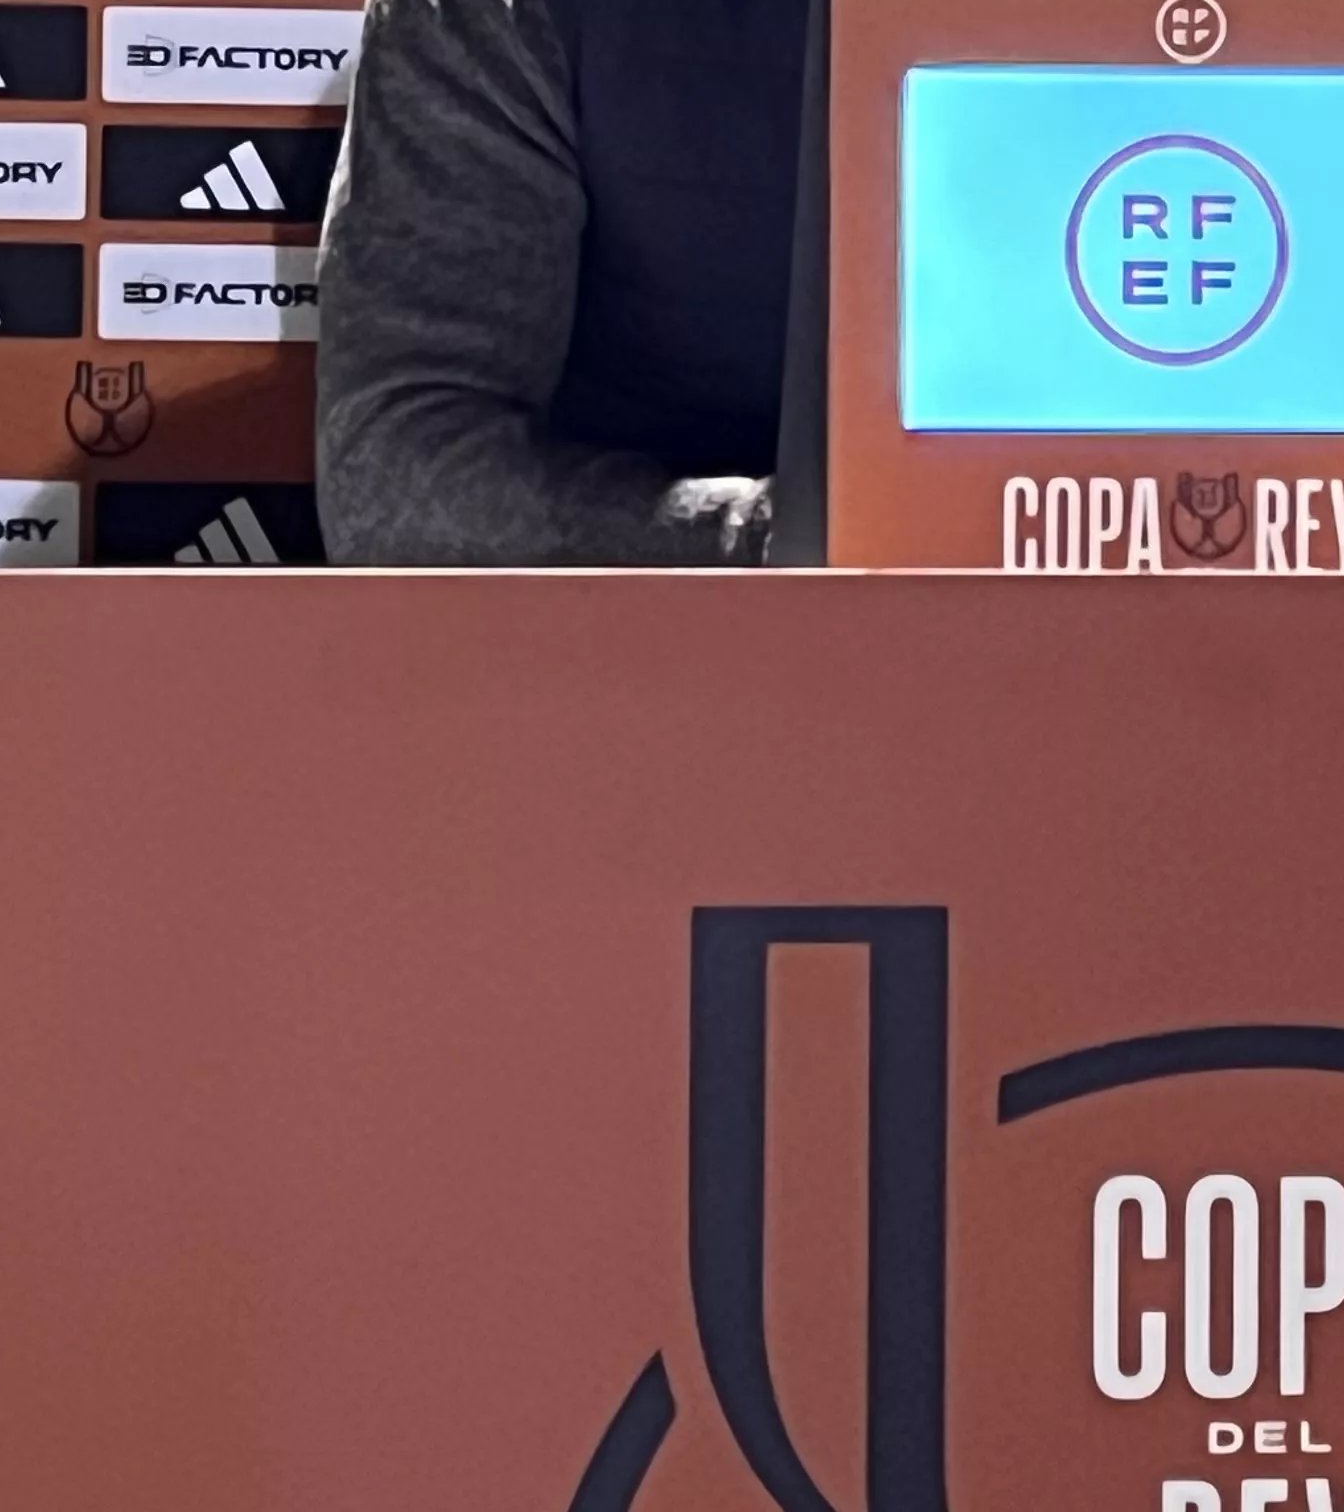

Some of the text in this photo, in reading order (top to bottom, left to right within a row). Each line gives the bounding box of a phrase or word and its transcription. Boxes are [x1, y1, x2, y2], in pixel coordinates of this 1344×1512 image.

[179, 46, 348, 72] FACTORY
[174, 283, 318, 308] FACTOR
[1004, 476, 1163, 573] COPA
[1207, 1420, 1332, 1455] DEL
